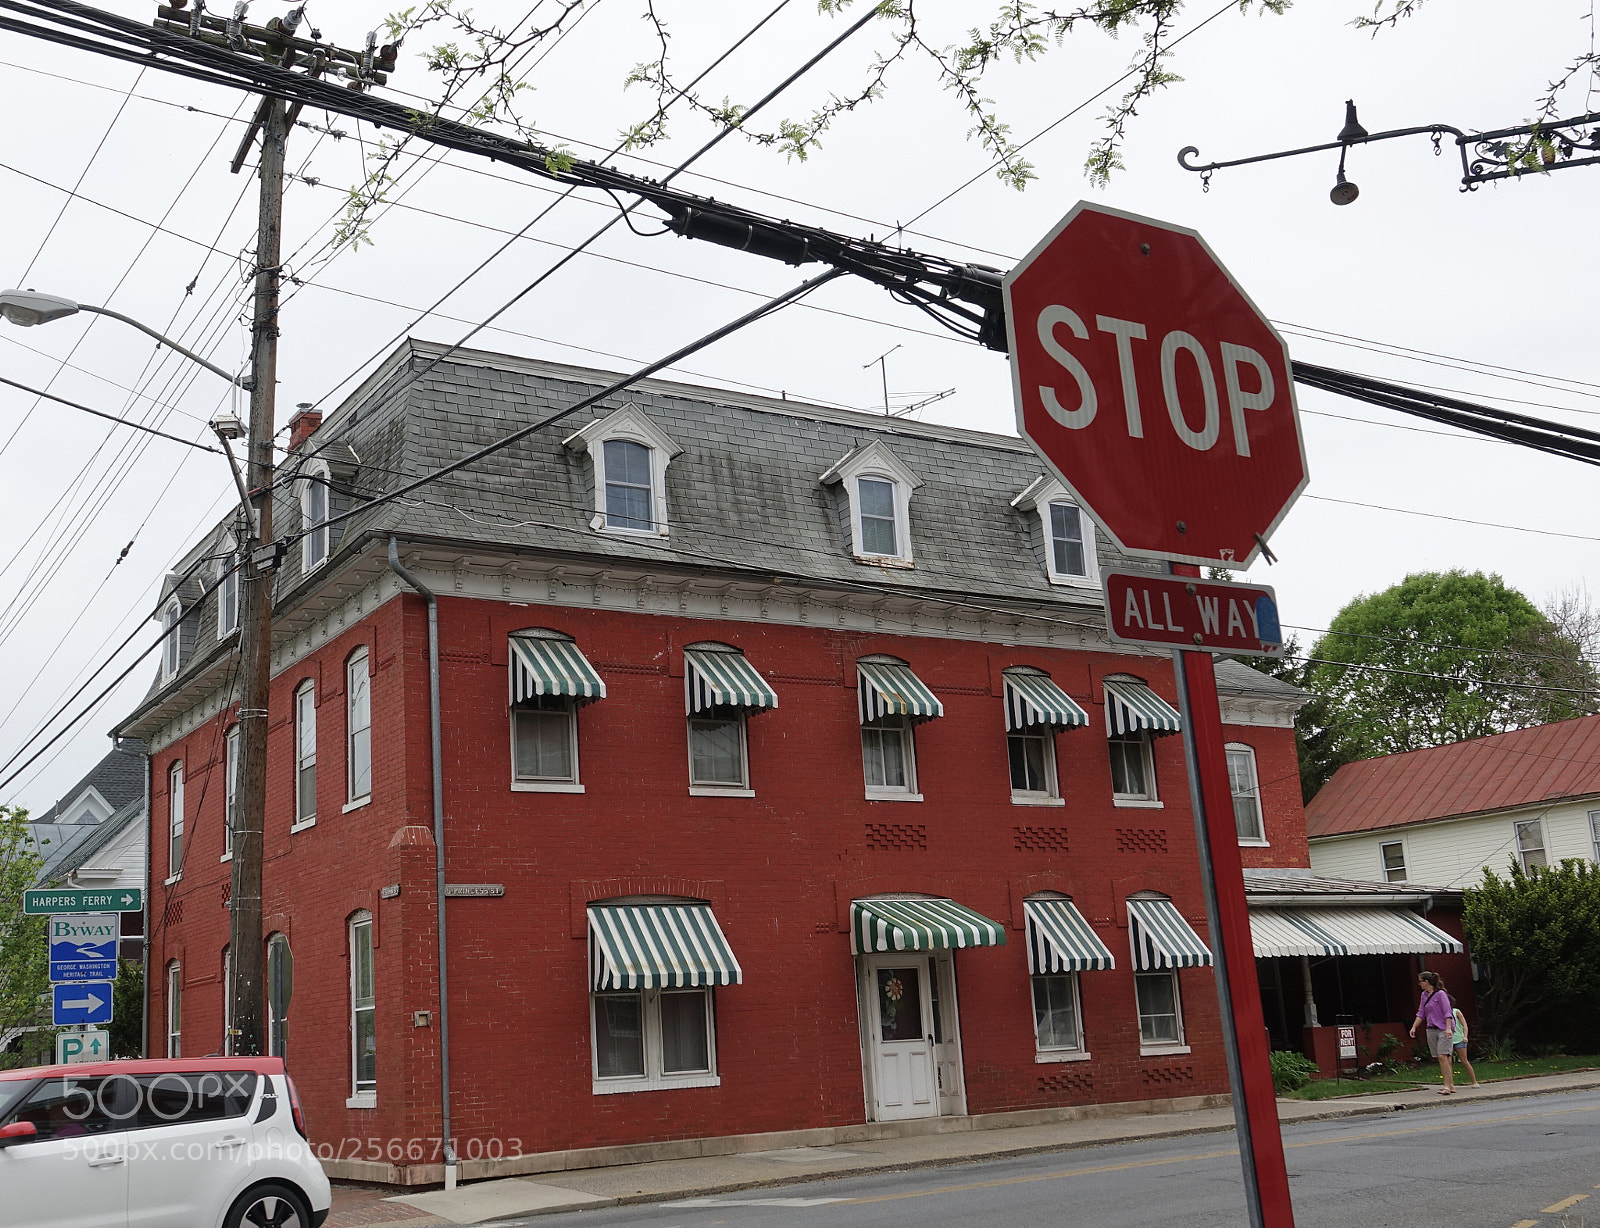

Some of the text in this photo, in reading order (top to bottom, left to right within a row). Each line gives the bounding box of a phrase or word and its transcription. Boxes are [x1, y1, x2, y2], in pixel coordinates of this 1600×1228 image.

[1037, 304, 1275, 458] STOP
[1124, 587, 1185, 632] ALL
[32, 895, 113, 907] HARPERS FERRY
[63, 1038, 83, 1064] P
[1340, 1038, 1353, 1046] RENT
